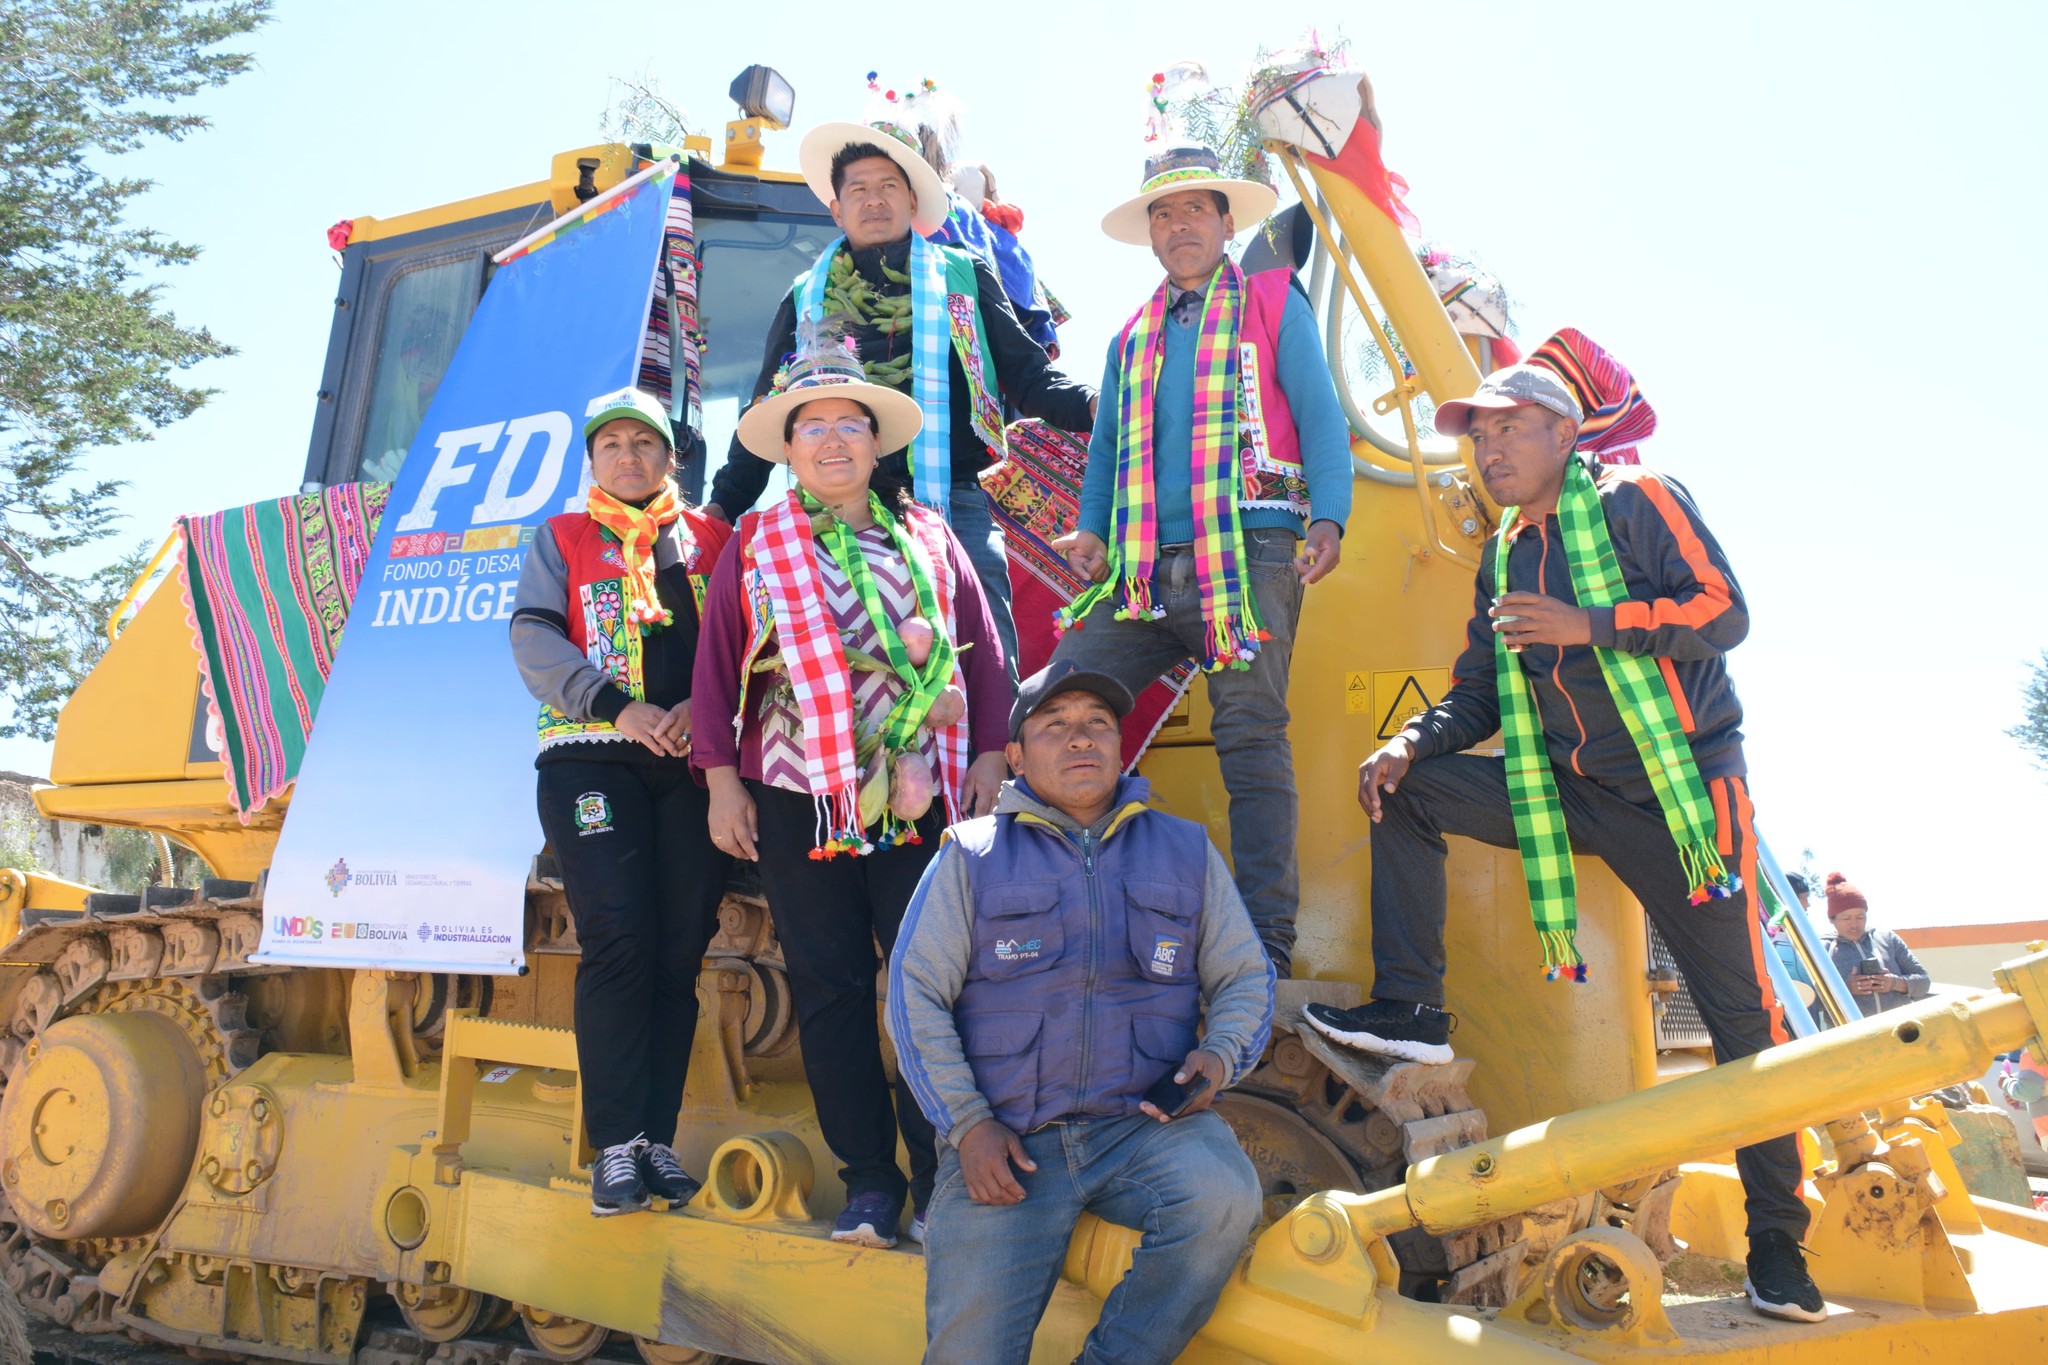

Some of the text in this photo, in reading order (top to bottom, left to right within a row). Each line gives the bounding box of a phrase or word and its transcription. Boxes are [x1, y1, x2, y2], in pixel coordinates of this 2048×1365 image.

[383, 553, 522, 582] FONDO DE DESA
[371, 576, 519, 627] INDÍGE
[355, 873, 398, 886] BOLIVIA
[369, 930, 408, 940] BOLIVIA
[434, 925, 493, 934] BOLIVIA ES
[433, 933, 512, 944] INDUSTRIALIZACIÓN
[1153, 946, 1176, 963] ABC
